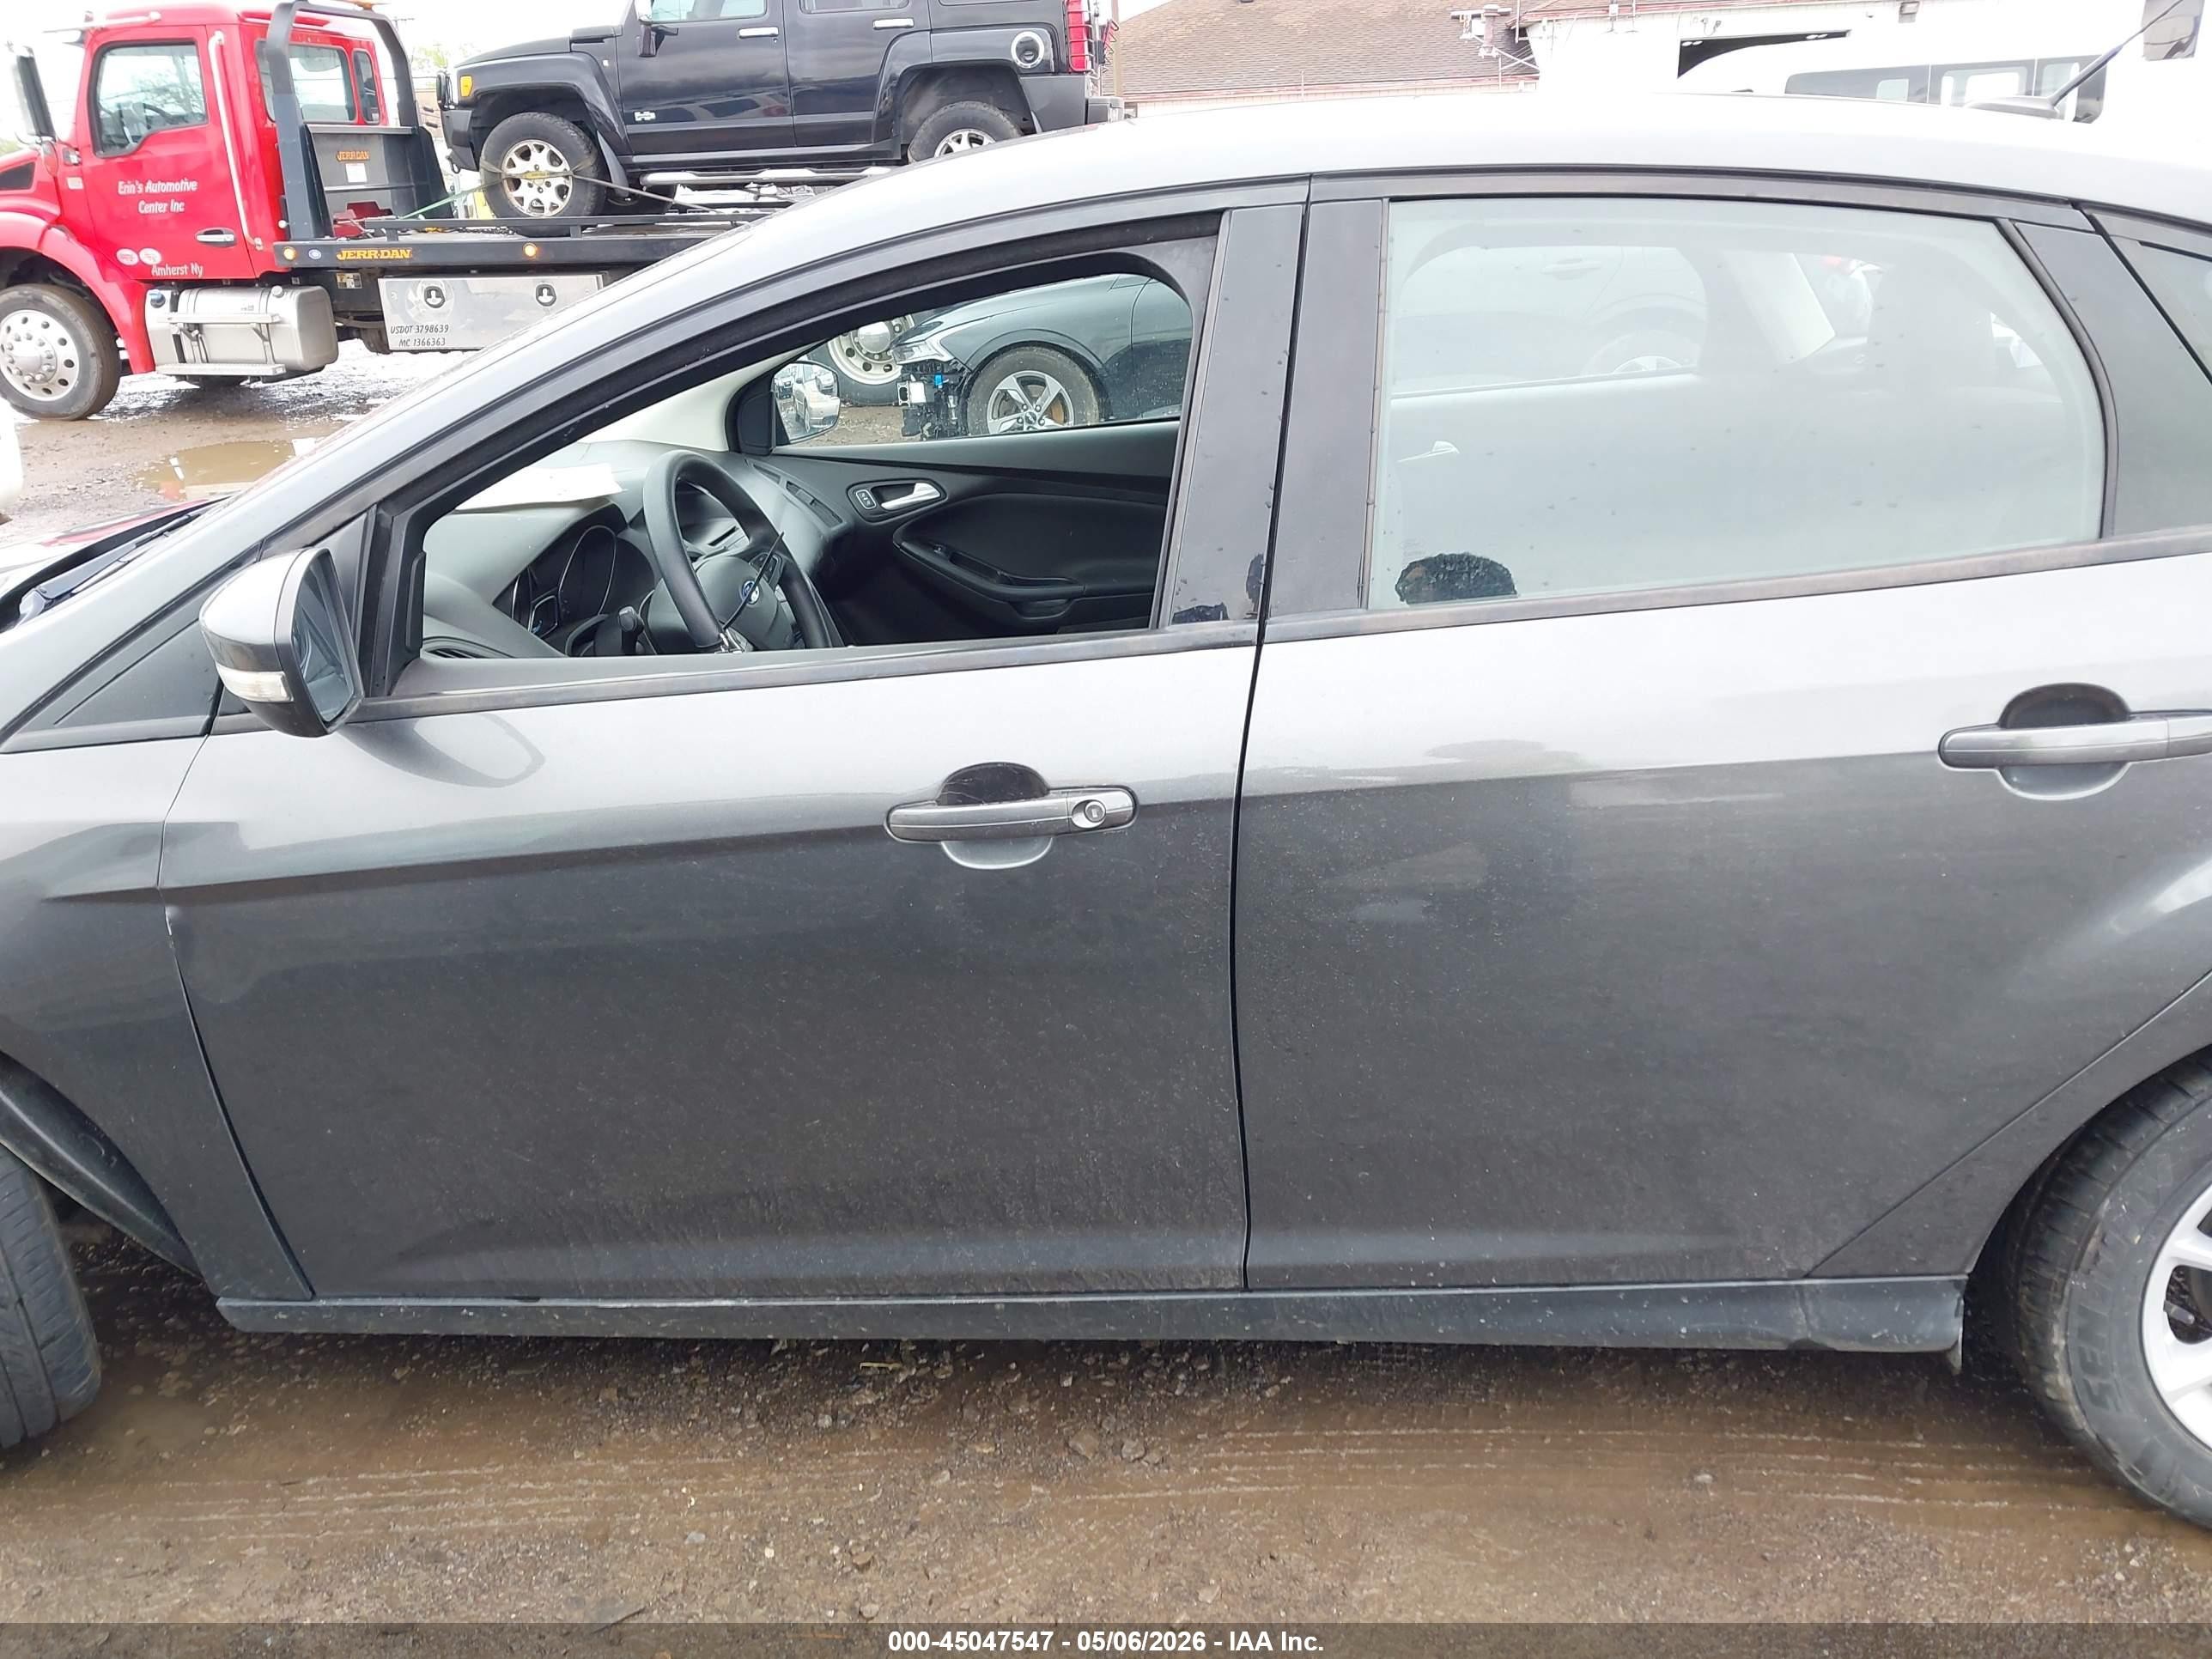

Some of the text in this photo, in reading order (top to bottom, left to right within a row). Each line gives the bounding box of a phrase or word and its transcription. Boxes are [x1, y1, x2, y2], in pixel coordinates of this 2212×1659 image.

[118, 179, 198, 194] Erin's Automotive
[138, 199, 185, 214] Center Inc
[151, 264, 188, 276] Amherst
[390, 324, 450, 335] USDOT 3798639
[398, 337, 446, 348] MC 1366363
